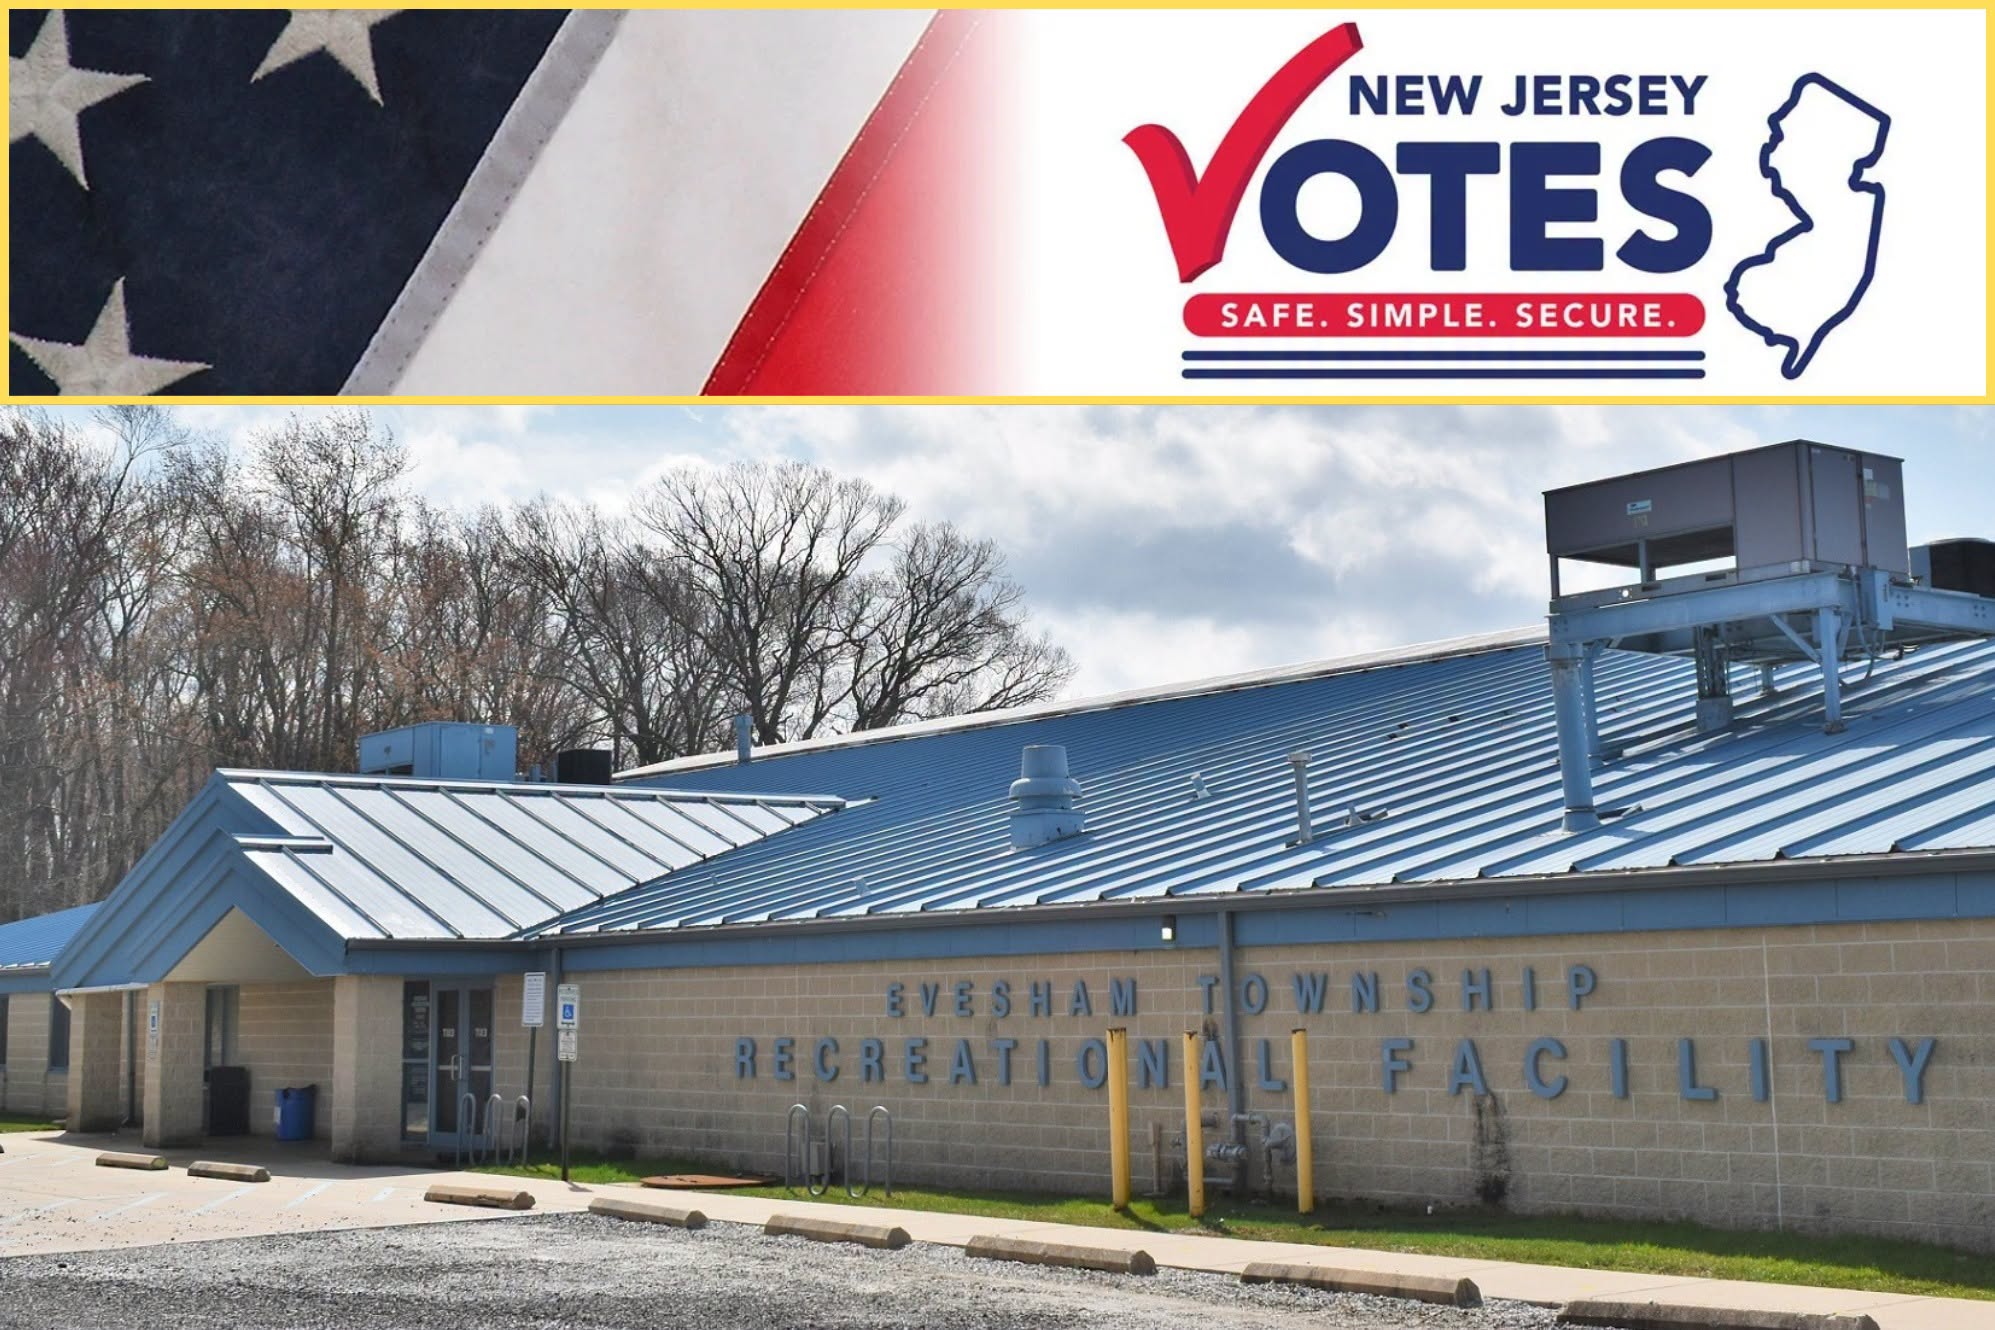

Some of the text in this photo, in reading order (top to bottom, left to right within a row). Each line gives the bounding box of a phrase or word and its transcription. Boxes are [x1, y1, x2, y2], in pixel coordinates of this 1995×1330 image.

[885, 964, 1598, 1018] EVESHAM TOWNSHIP
[734, 1037, 1936, 1104] RECREATIONAL FACILITY
